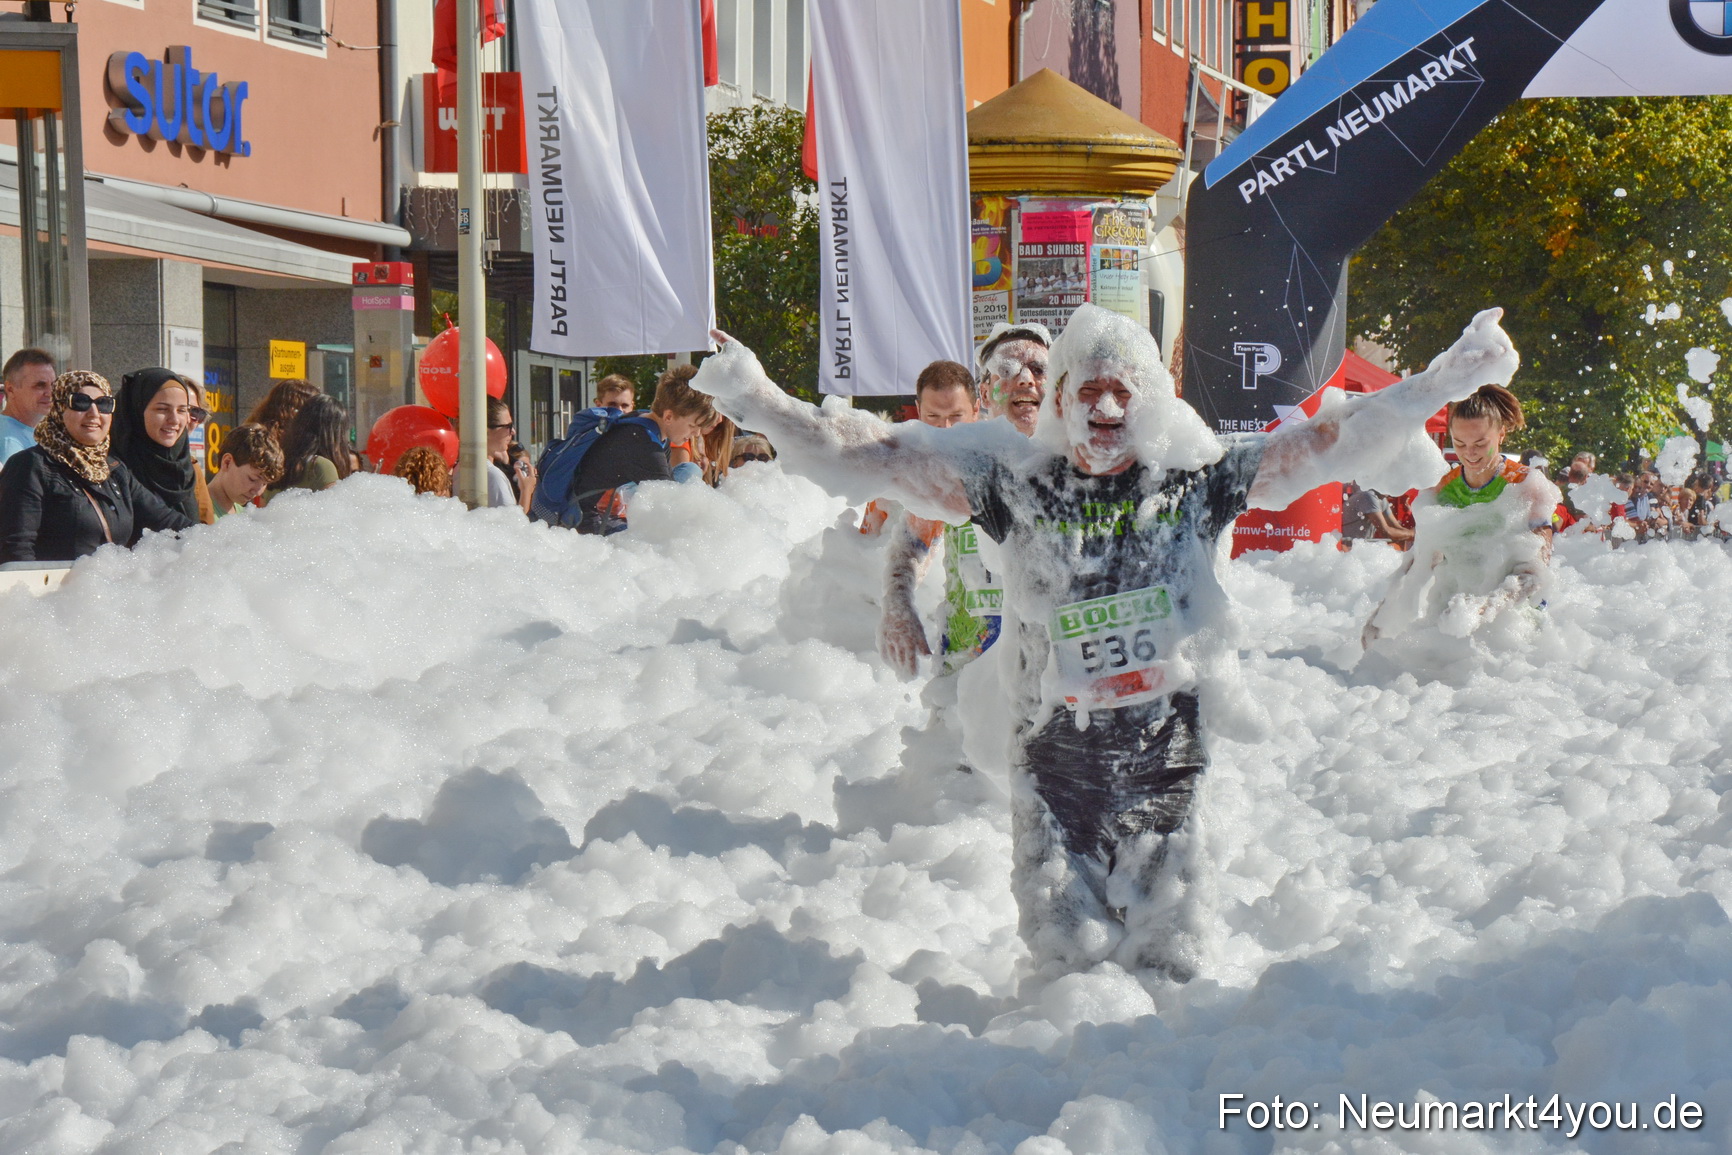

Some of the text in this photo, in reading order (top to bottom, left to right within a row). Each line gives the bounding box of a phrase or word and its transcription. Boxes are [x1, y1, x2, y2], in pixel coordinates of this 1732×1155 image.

[1238, 36, 1478, 204] PARTL NEUMARKT
[1019, 244, 1085, 255] BAND SUNRISE
[362, 297, 391, 305] HotSpot
[1049, 295, 1085, 304] 20 JAHRE
[984, 305, 1007, 313] 2019
[1020, 309, 1058, 317] Gottesdienst
[1219, 420, 1268, 430] THE NEXT
[1081, 629, 1156, 673] 536
